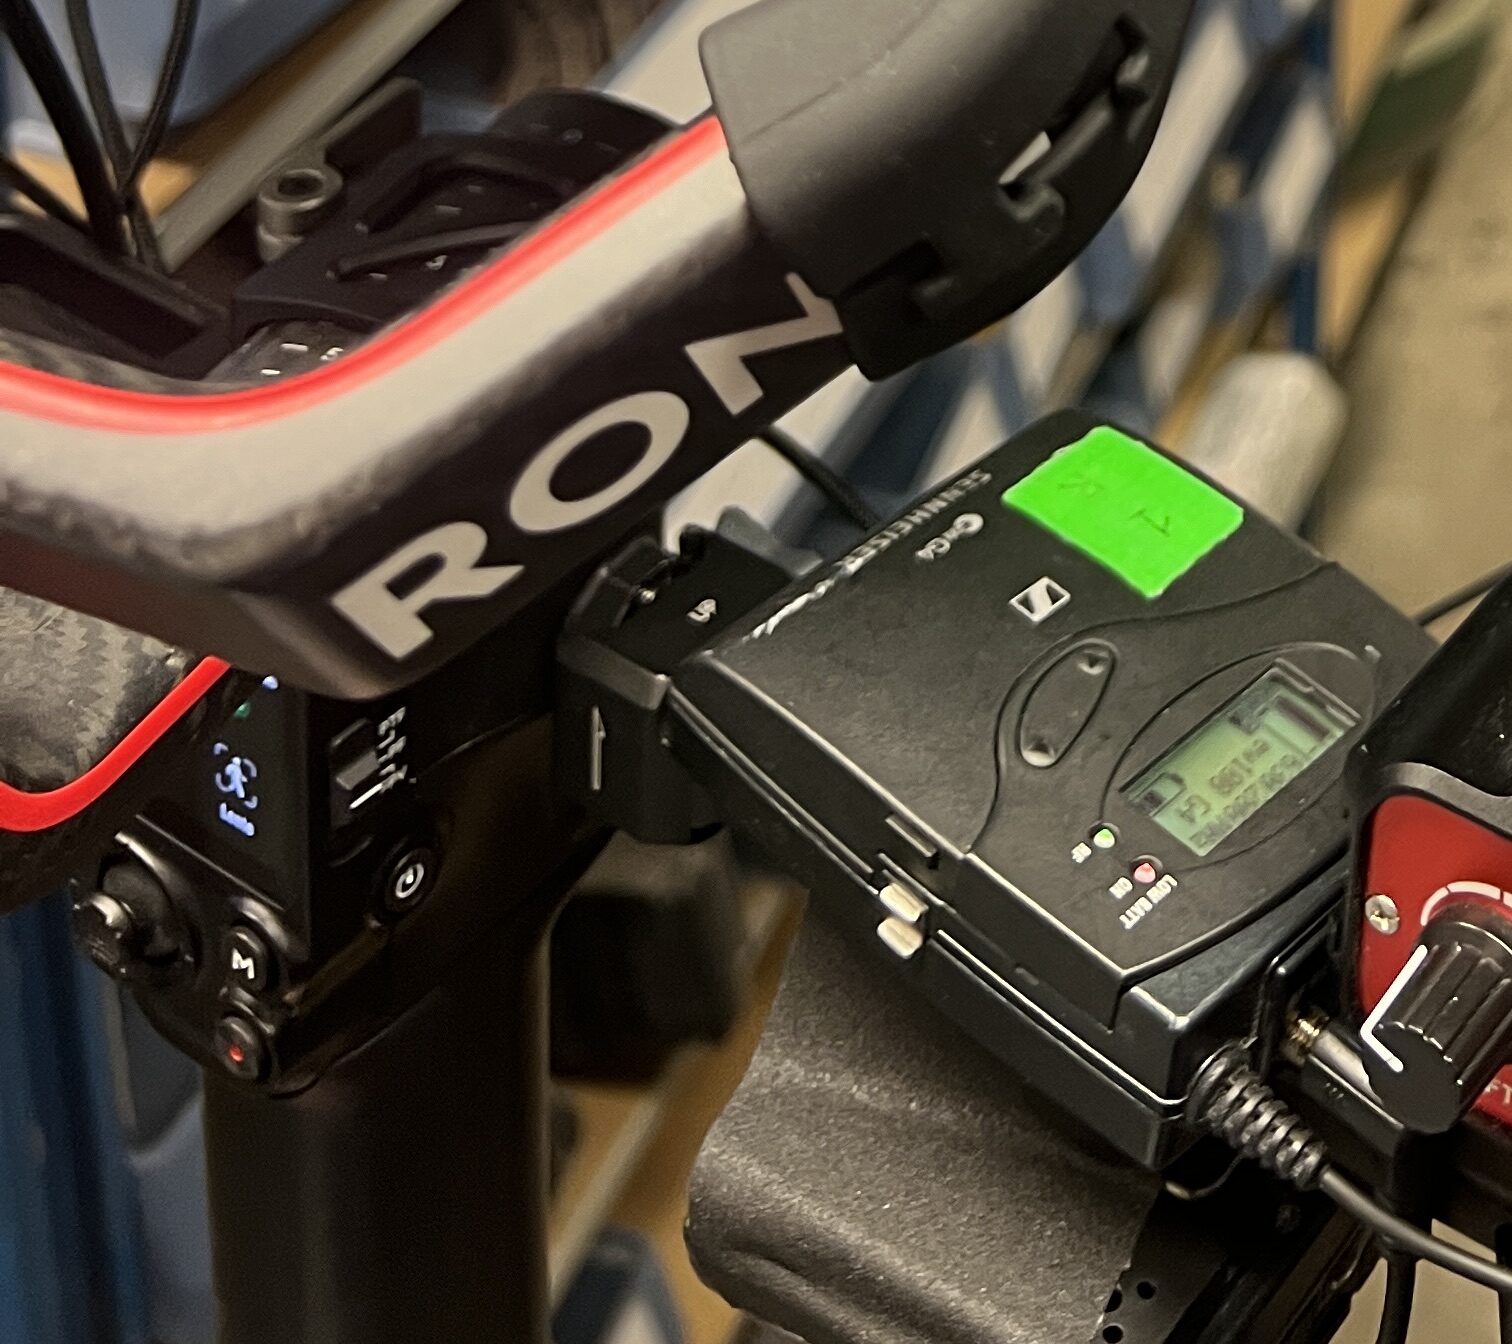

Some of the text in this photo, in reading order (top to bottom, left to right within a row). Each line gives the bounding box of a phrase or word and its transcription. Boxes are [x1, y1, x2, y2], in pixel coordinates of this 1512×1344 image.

[1119, 874, 1178, 929] LOW BATT
[231, 947, 255, 979] M
